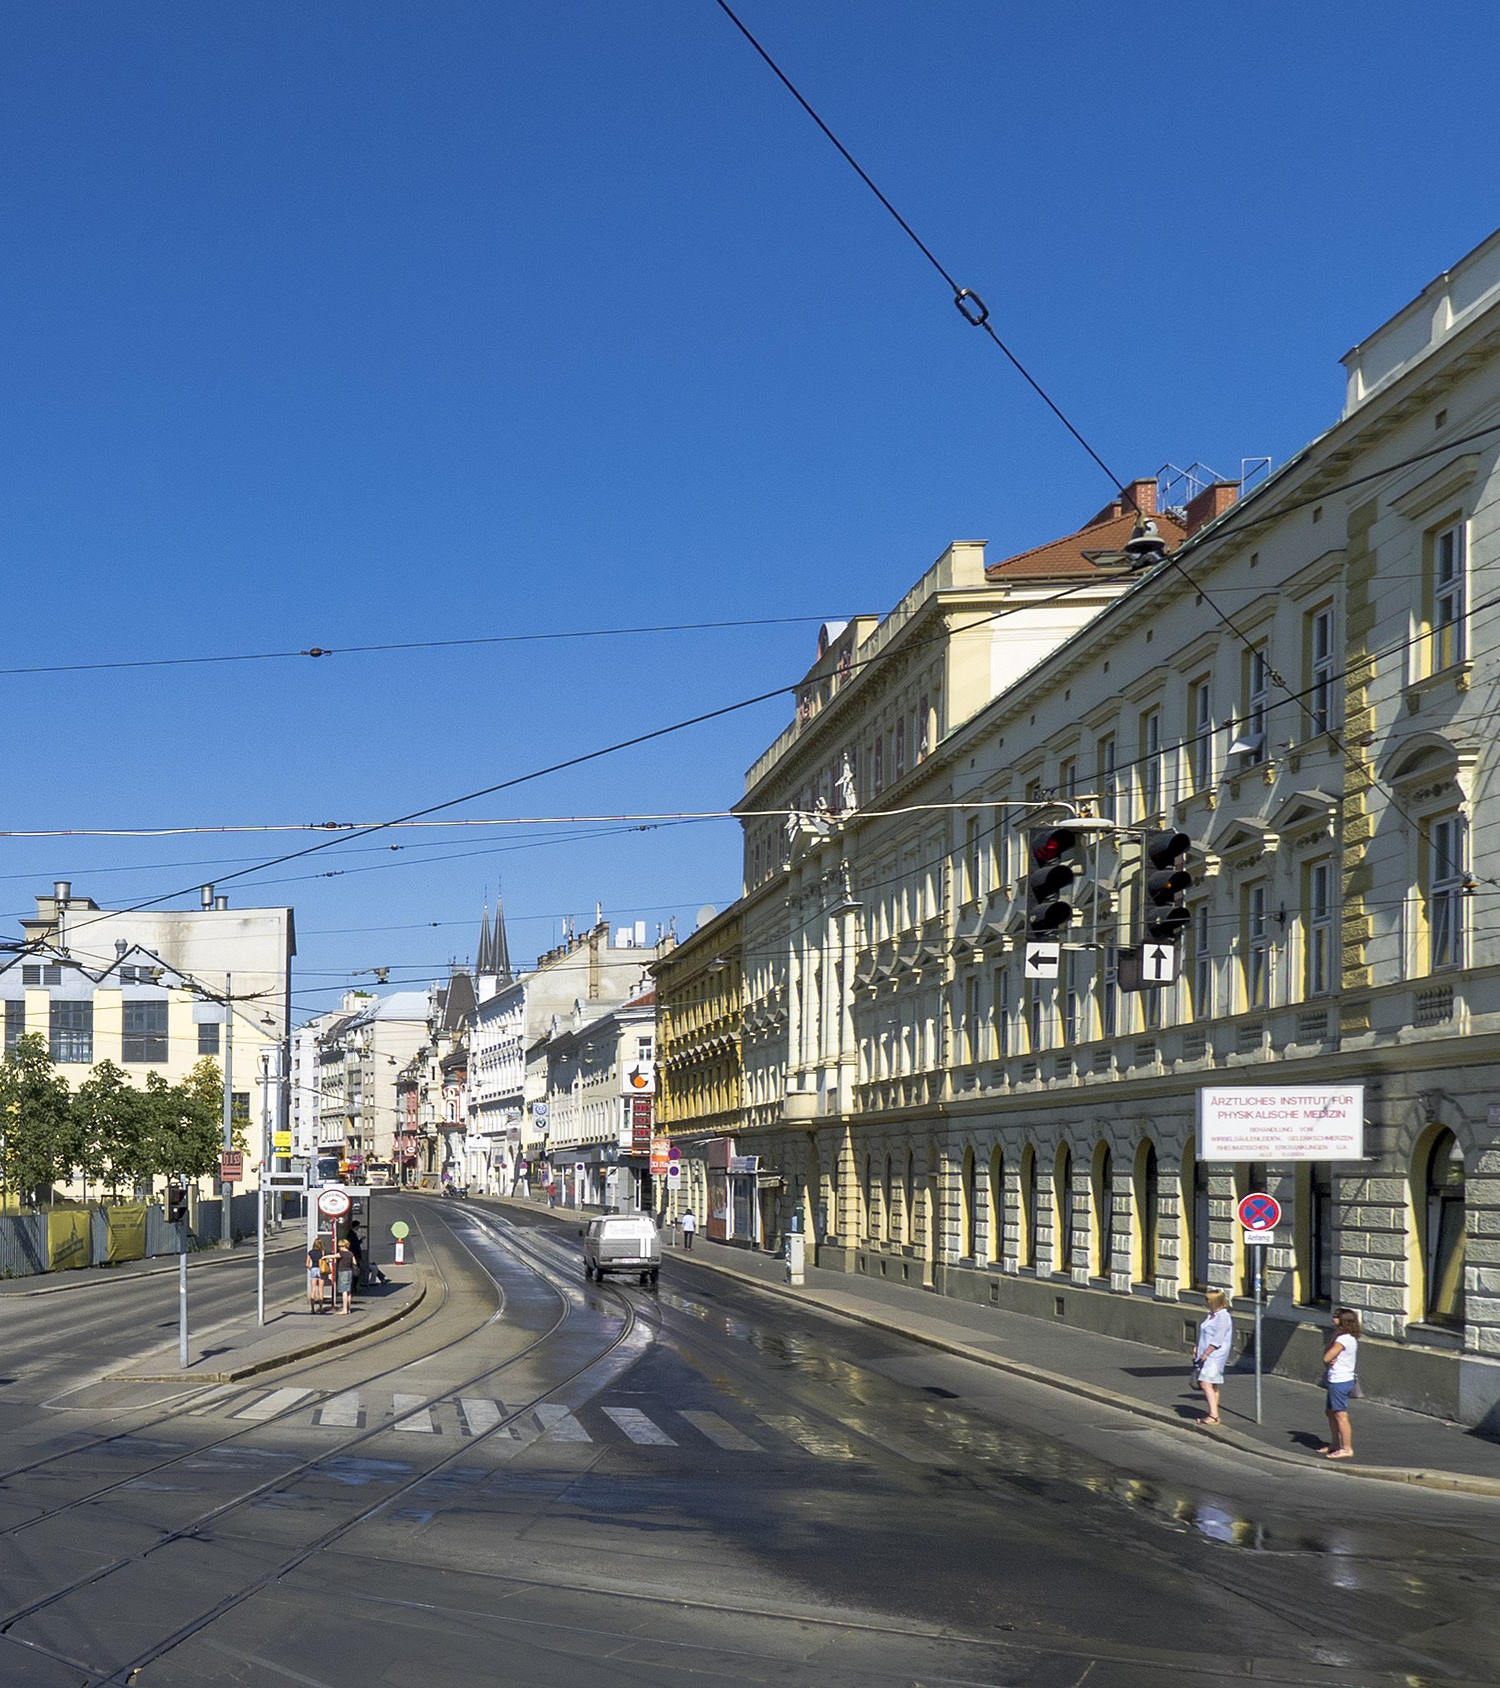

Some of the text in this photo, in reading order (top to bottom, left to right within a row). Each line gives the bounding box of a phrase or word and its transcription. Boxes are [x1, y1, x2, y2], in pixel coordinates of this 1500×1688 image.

[1210, 1094, 1354, 1106] ÄRZTLICHES INSTITUT FÜR
[1303, 1109, 1347, 1119] MEDIZIN
